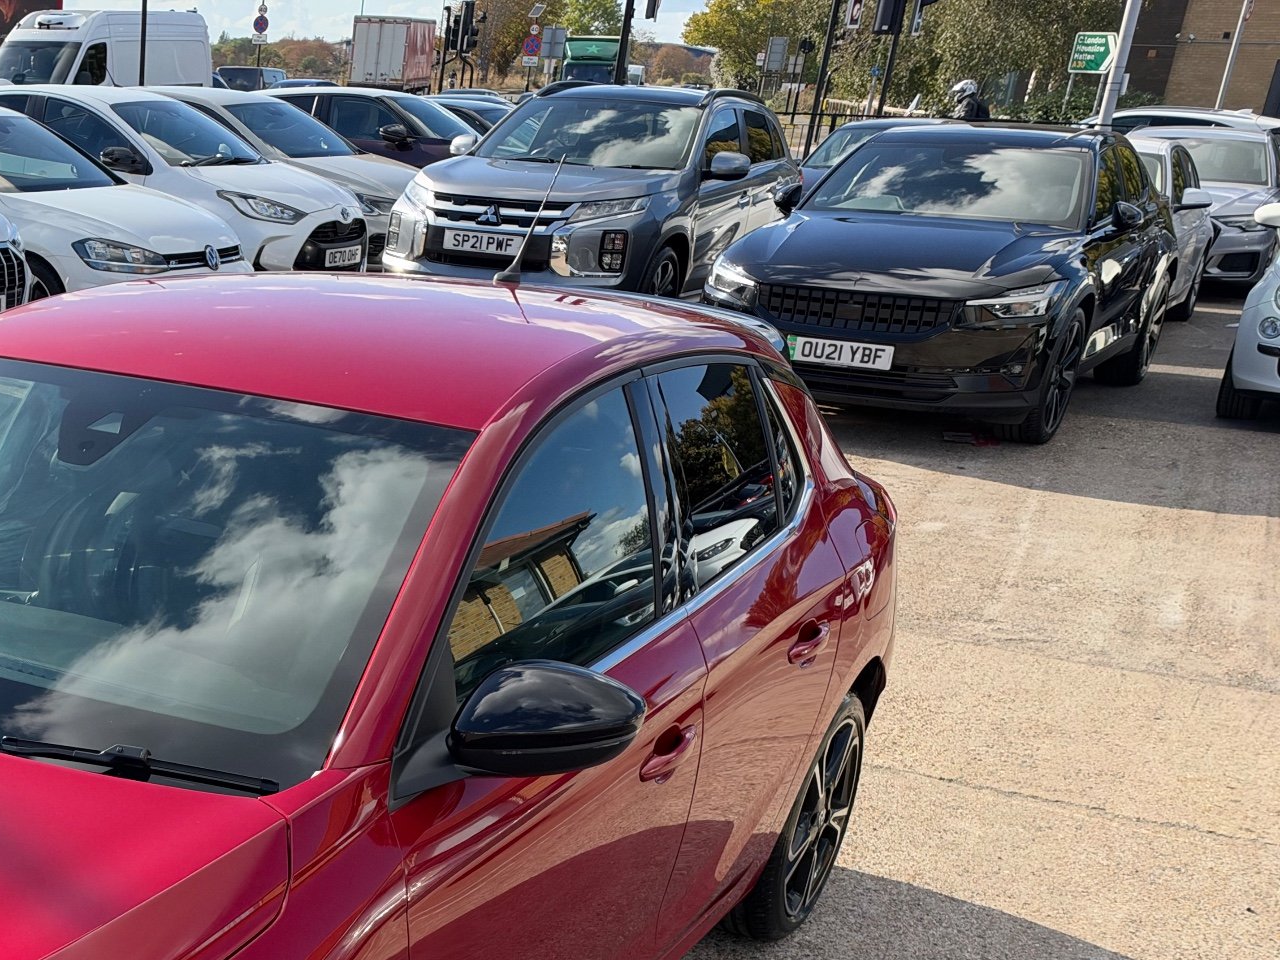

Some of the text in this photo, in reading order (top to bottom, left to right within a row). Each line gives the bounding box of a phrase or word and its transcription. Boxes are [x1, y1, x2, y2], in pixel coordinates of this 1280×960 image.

[1084, 36, 1106, 44] London
[1075, 44, 1106, 52] Hounslow
[1071, 61, 1086, 69] A30
[452, 233, 514, 252] SP21 PWF
[328, 250, 347, 264] OE70
[801, 340, 886, 365] OU21 YBF
